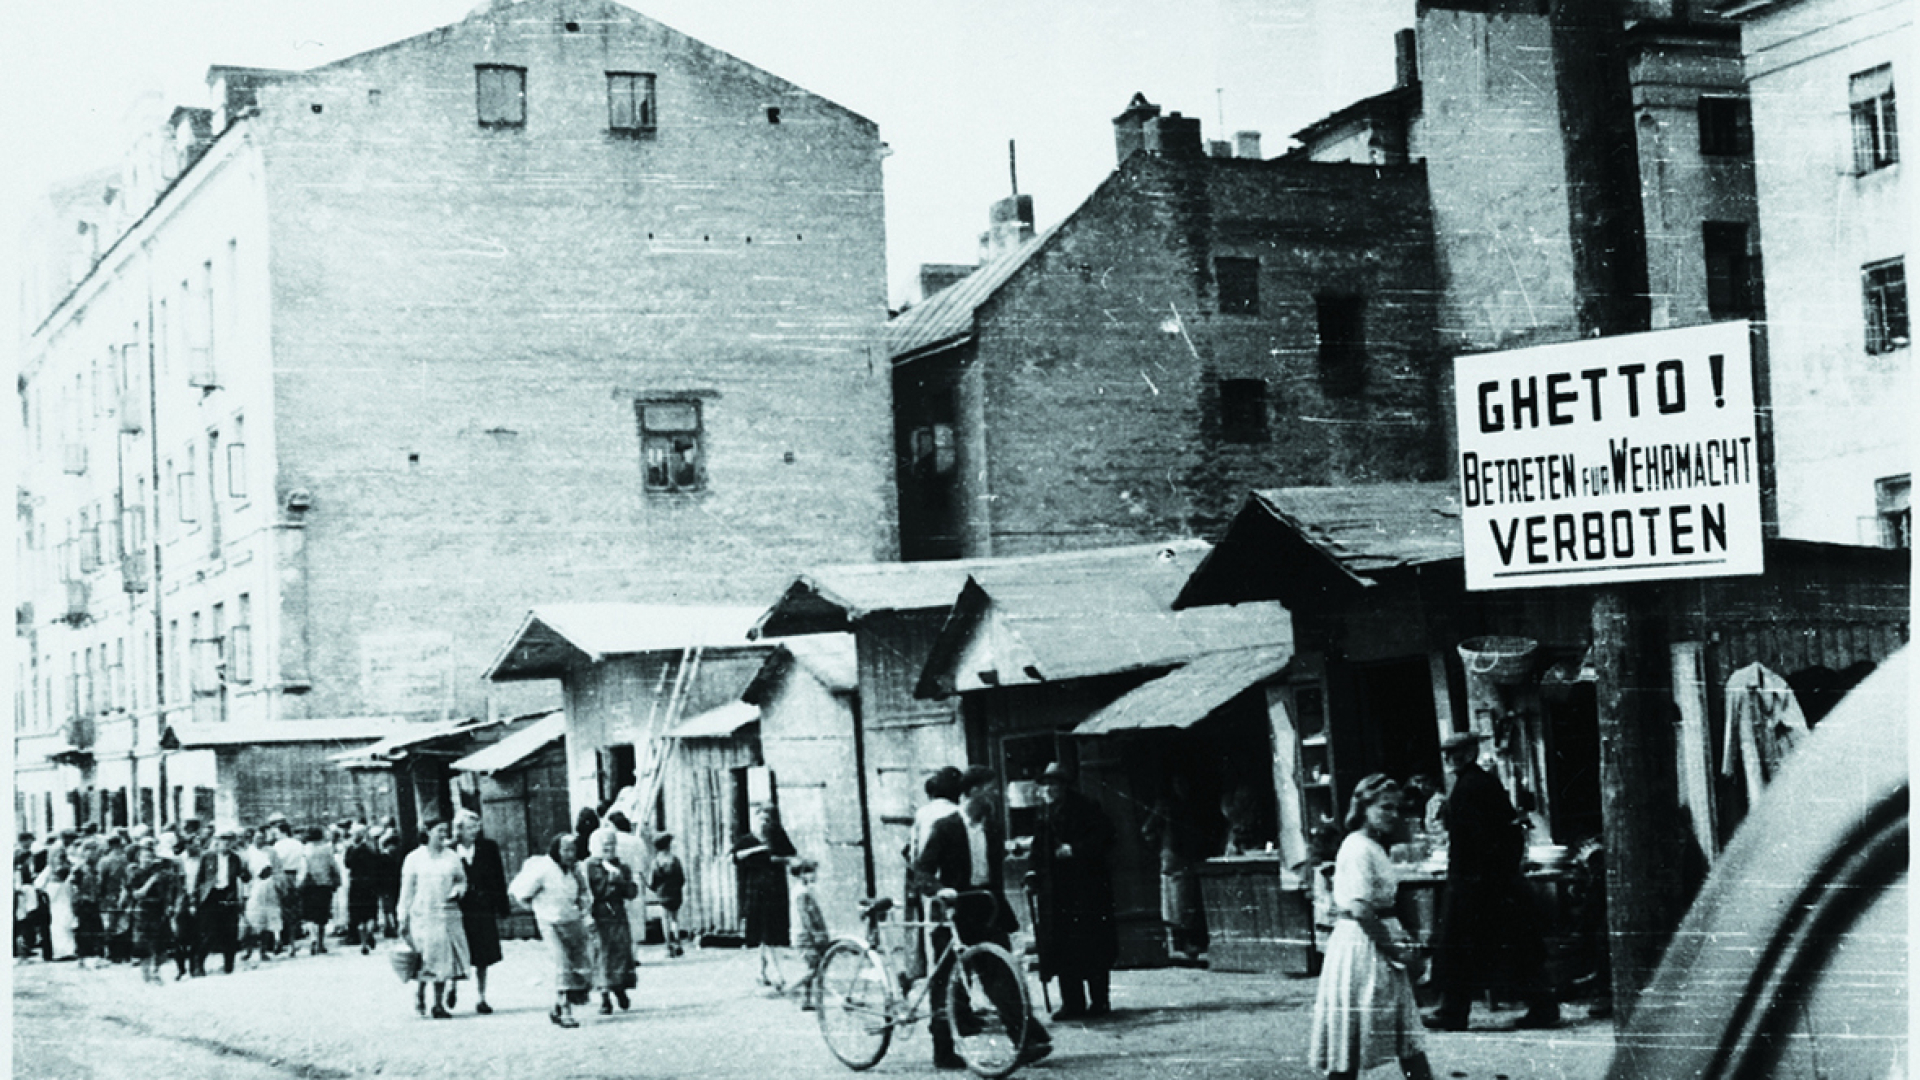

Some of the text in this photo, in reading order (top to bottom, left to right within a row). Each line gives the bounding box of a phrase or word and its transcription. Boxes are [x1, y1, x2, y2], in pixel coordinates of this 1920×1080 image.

[1478, 359, 1686, 433] GHETTO
[1463, 452, 1576, 507] BETRETEN
[1609, 437, 1751, 494] WEHRMACHT
[1489, 502, 1727, 566] VERBOTEN
